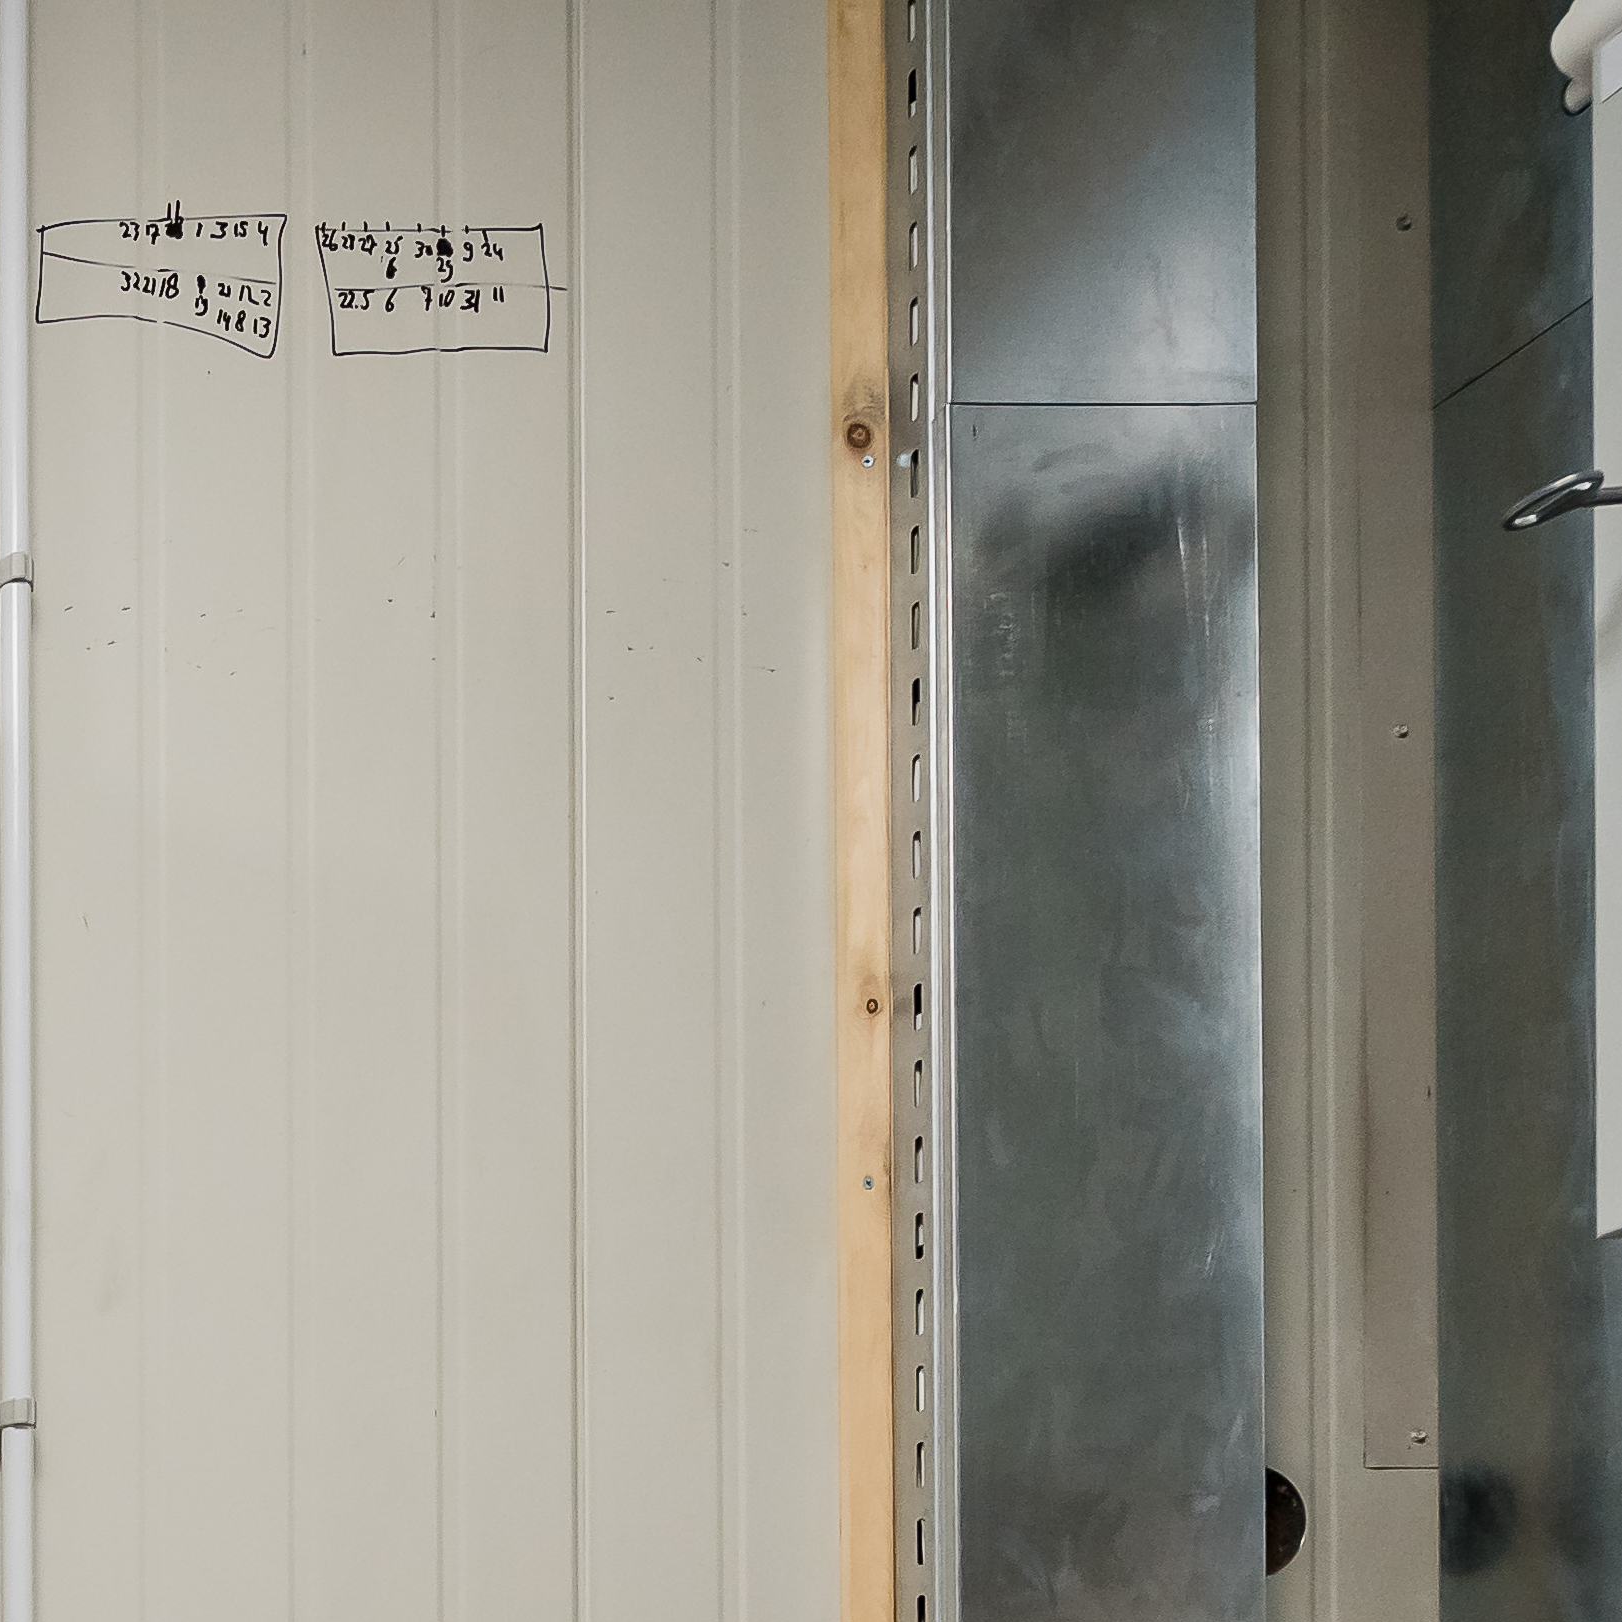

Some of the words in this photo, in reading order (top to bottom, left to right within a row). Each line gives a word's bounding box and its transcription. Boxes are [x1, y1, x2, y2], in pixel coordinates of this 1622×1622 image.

[119, 221, 140, 241] 23
[210, 221, 228, 239] 3
[233, 221, 249, 238] 15
[257, 221, 269, 246] 4
[463, 241, 474, 262] 9
[260, 289, 271, 307] 2
[385, 288, 398, 312] 6
[421, 286, 432, 311] 7
[439, 290, 455, 307] 10
[234, 310, 246, 332] 8
[253, 316, 271, 338] 13
